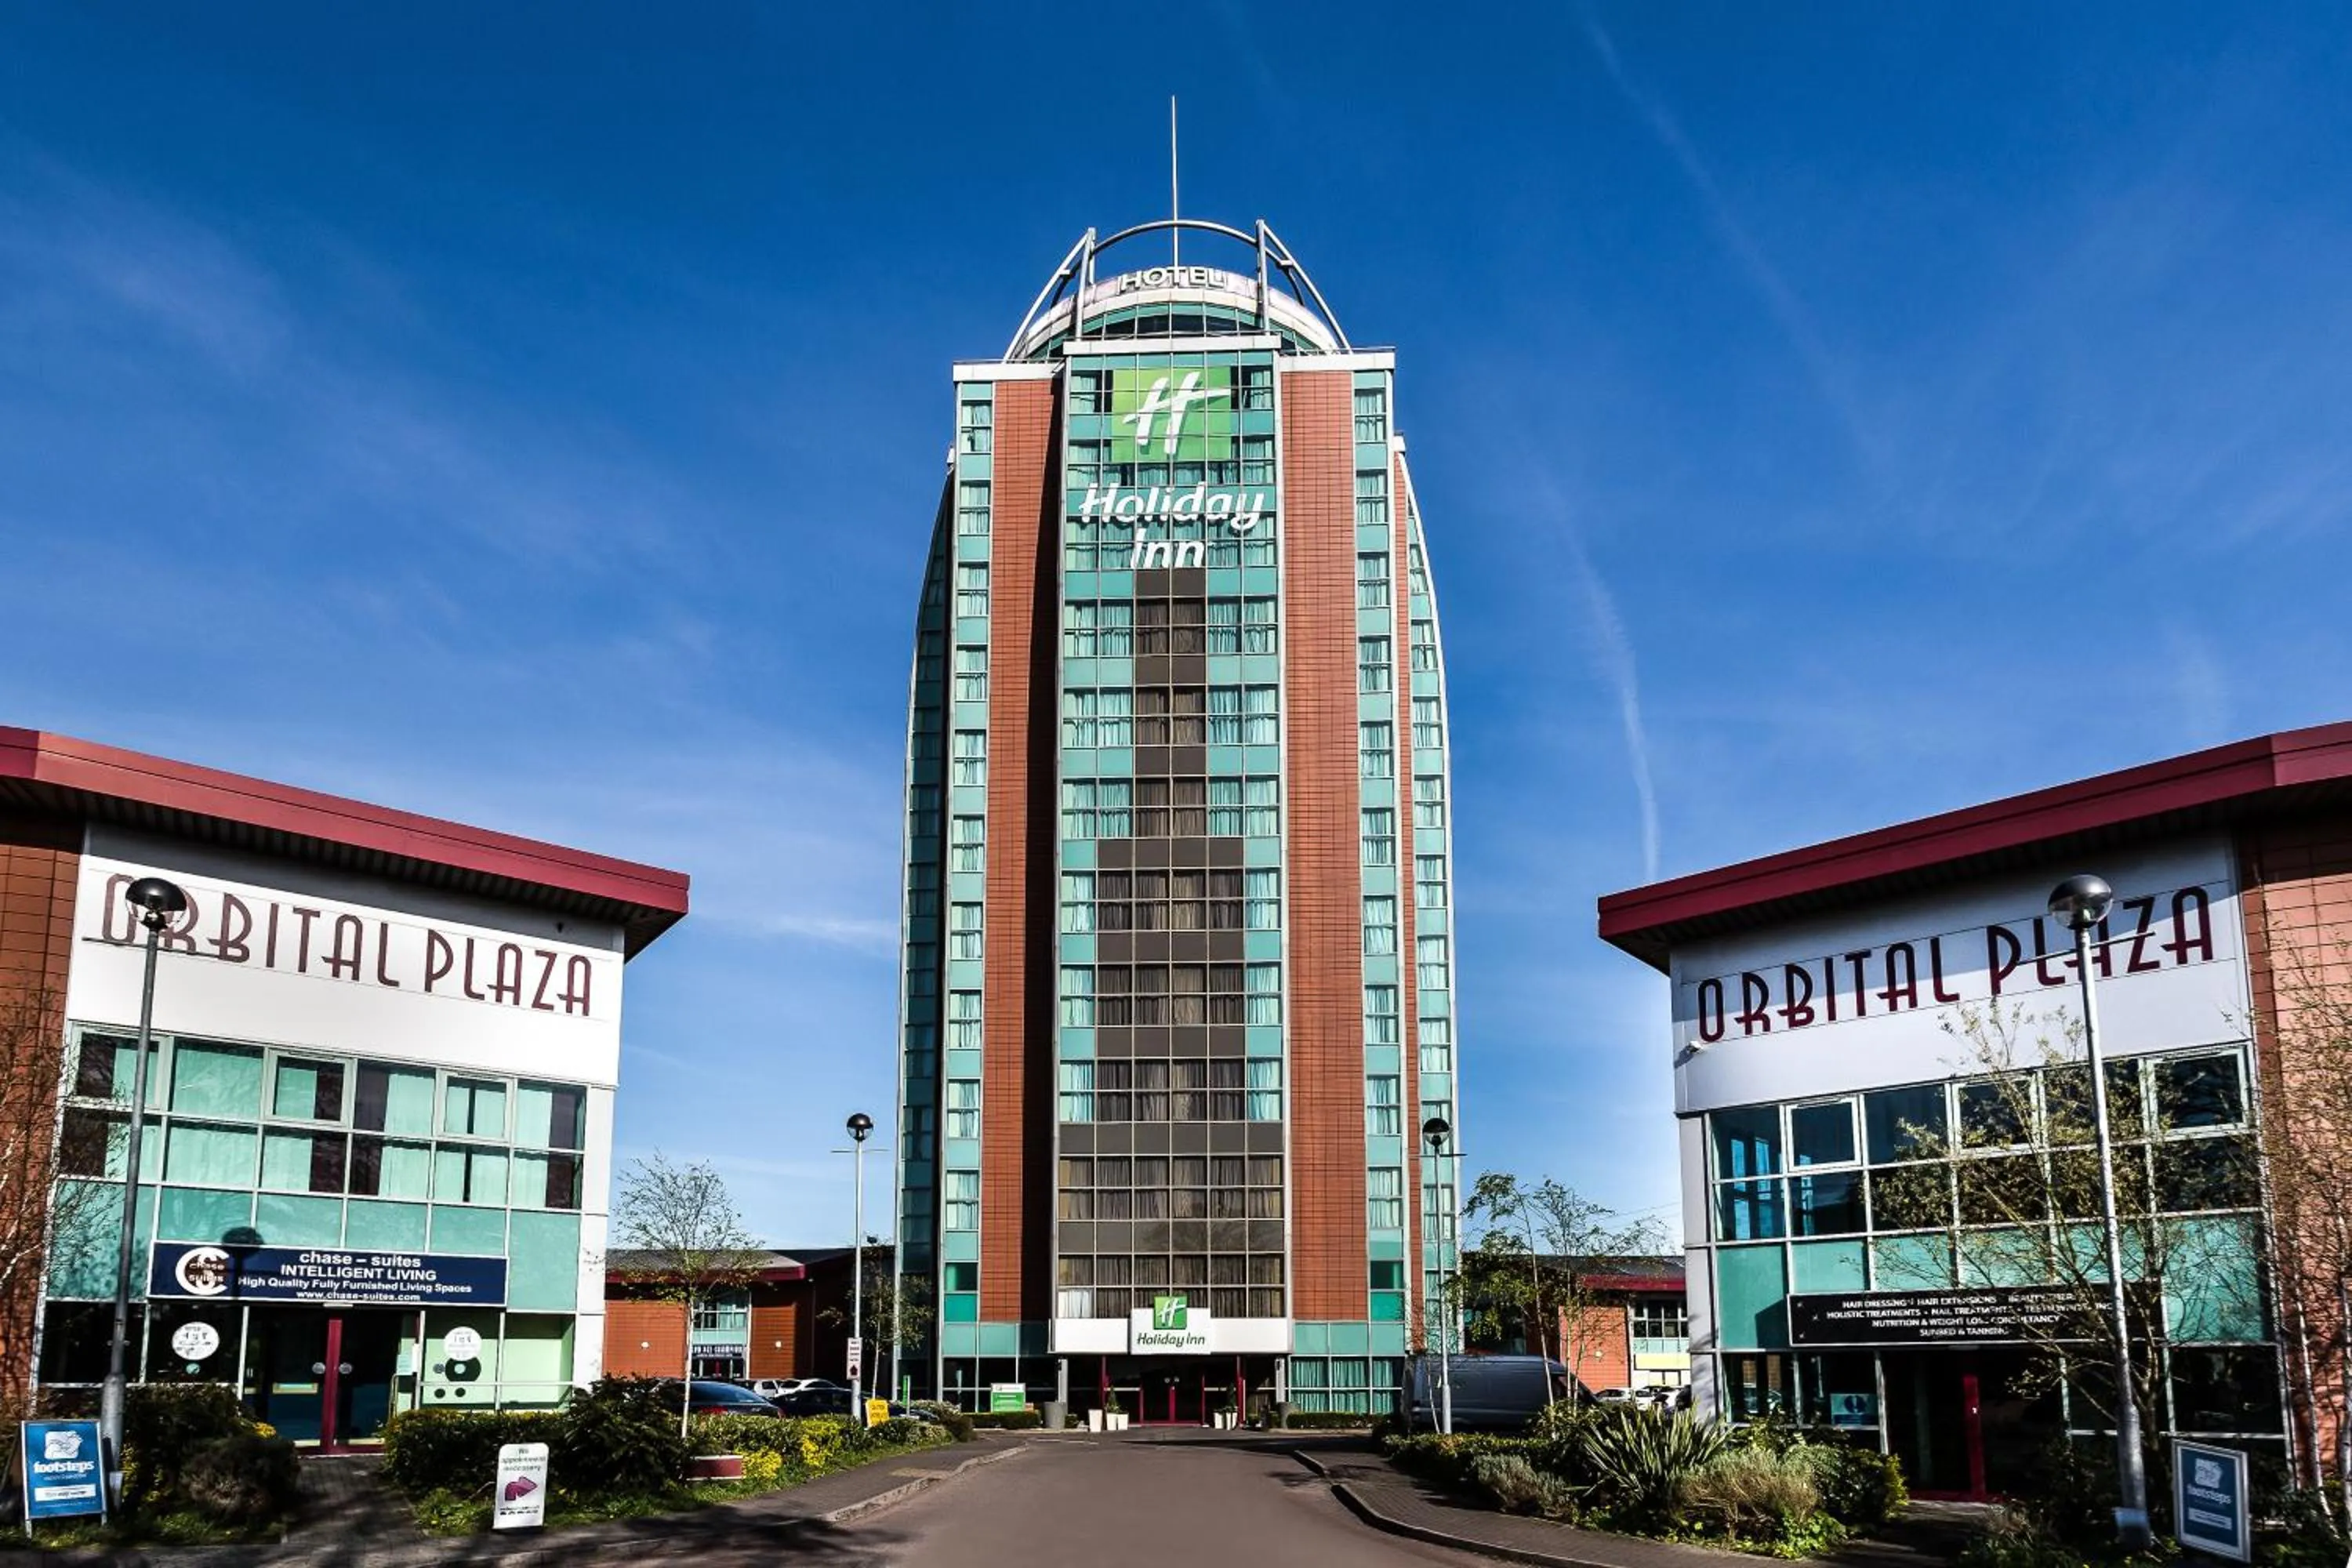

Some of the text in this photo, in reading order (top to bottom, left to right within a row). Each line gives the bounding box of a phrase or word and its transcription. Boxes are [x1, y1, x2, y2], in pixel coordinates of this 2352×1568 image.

[1120, 267, 1226, 290] HOTEL
[1079, 481, 1265, 531] Holiday
[1130, 528, 1205, 568] Inn
[102, 873, 591, 1017] ORBITAL PLAZA
[1697, 886, 2213, 1043] ORBITAL PLAZA
[299, 1251, 352, 1265] chase
[372, 1254, 421, 1267] suites
[281, 1265, 437, 1280] INTELLIGENT LIVING
[238, 1277, 472, 1294] High Quality Fully Furnished Living Spaces
[296, 1290, 421, 1301] www.chase-suites.com
[1864, 1299, 1907, 1308] DRESSING
[1827, 1310, 1864, 1319] HOLISTIC
[1865, 1308, 1921, 1317] TREATMENTS
[1871, 1318, 1919, 1327] NUTRITION
[1929, 1317, 1964, 1326] WEIGHT
[1137, 1332, 1205, 1348] Holiday Inn
[34, 1461, 94, 1473] footsteps
